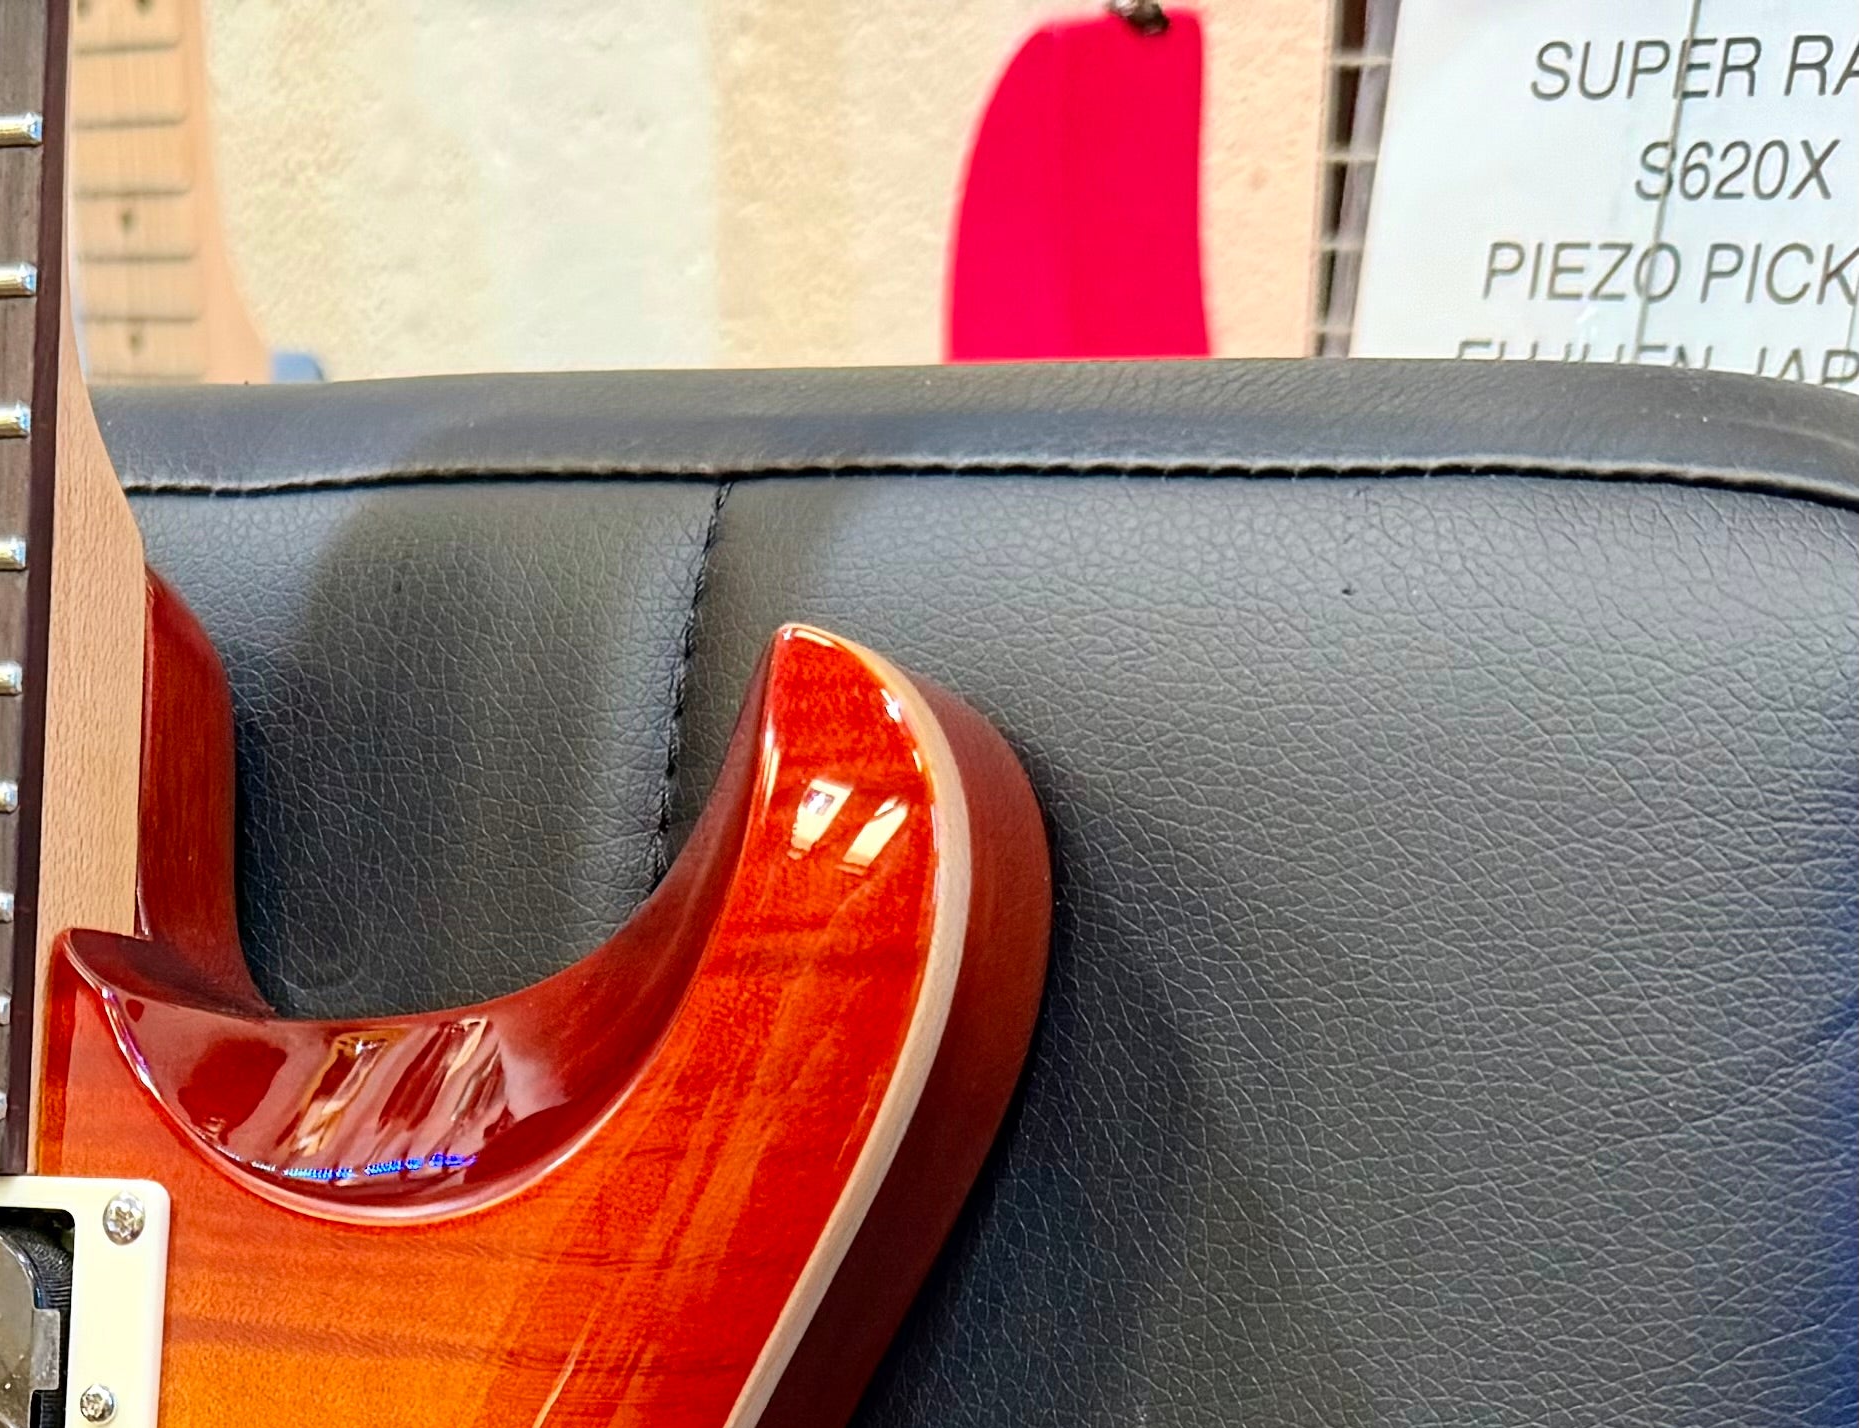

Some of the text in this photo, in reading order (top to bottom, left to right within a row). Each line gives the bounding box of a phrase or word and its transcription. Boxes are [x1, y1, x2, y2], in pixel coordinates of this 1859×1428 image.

[1530, 36, 1763, 101] SUPER
[1634, 138, 1841, 201] S620X
[1483, 240, 1859, 305] PIEZO PICK
